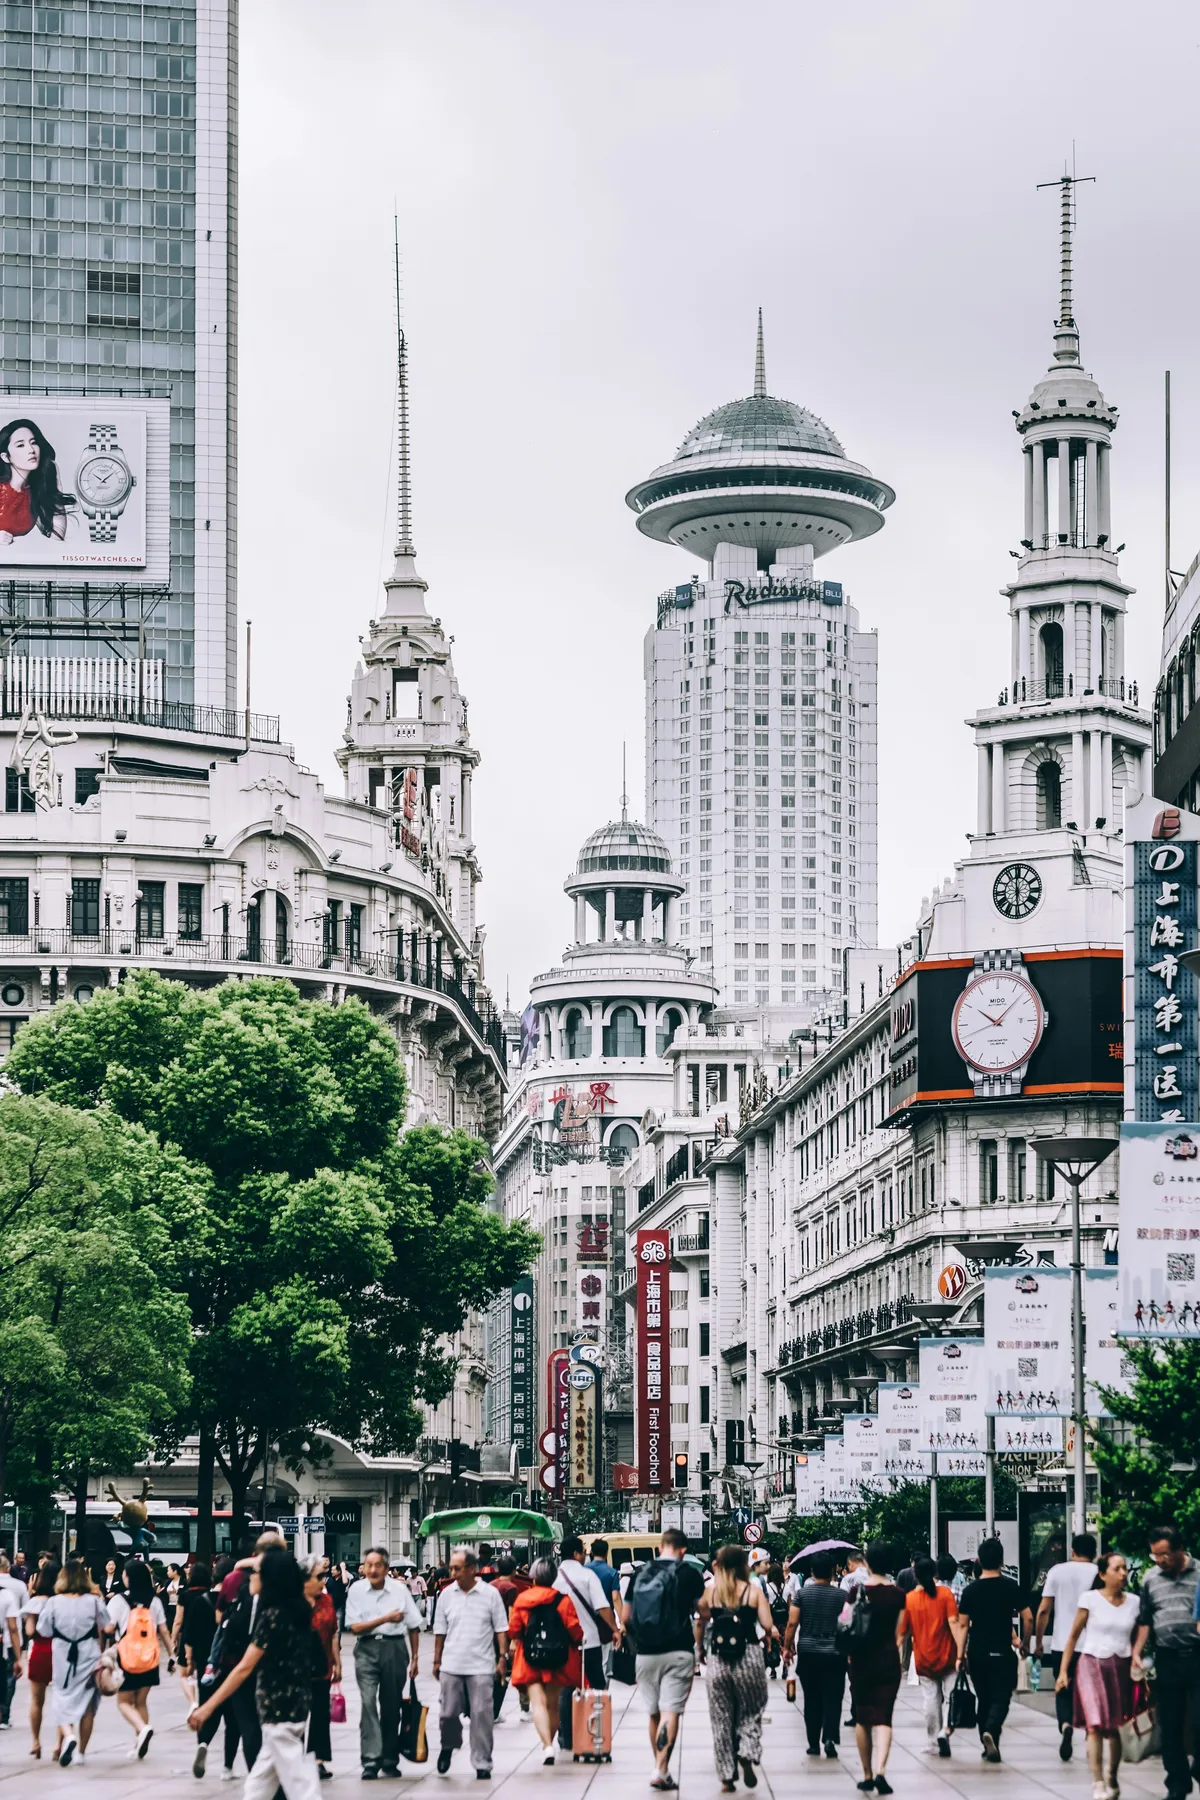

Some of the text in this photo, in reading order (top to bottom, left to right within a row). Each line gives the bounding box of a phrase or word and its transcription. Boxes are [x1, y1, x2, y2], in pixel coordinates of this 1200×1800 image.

[61, 555, 142, 563] TISSOTWATCHES.CN
[724, 572, 842, 614] Radisson BLU
[1100, 1023, 1123, 1031] SWI
[646, 1269, 662, 1400] 上海市第一食品商店
[513, 1317, 525, 1450] 上海市第一百货商店
[649, 1408, 659, 1485] First Foodhall
